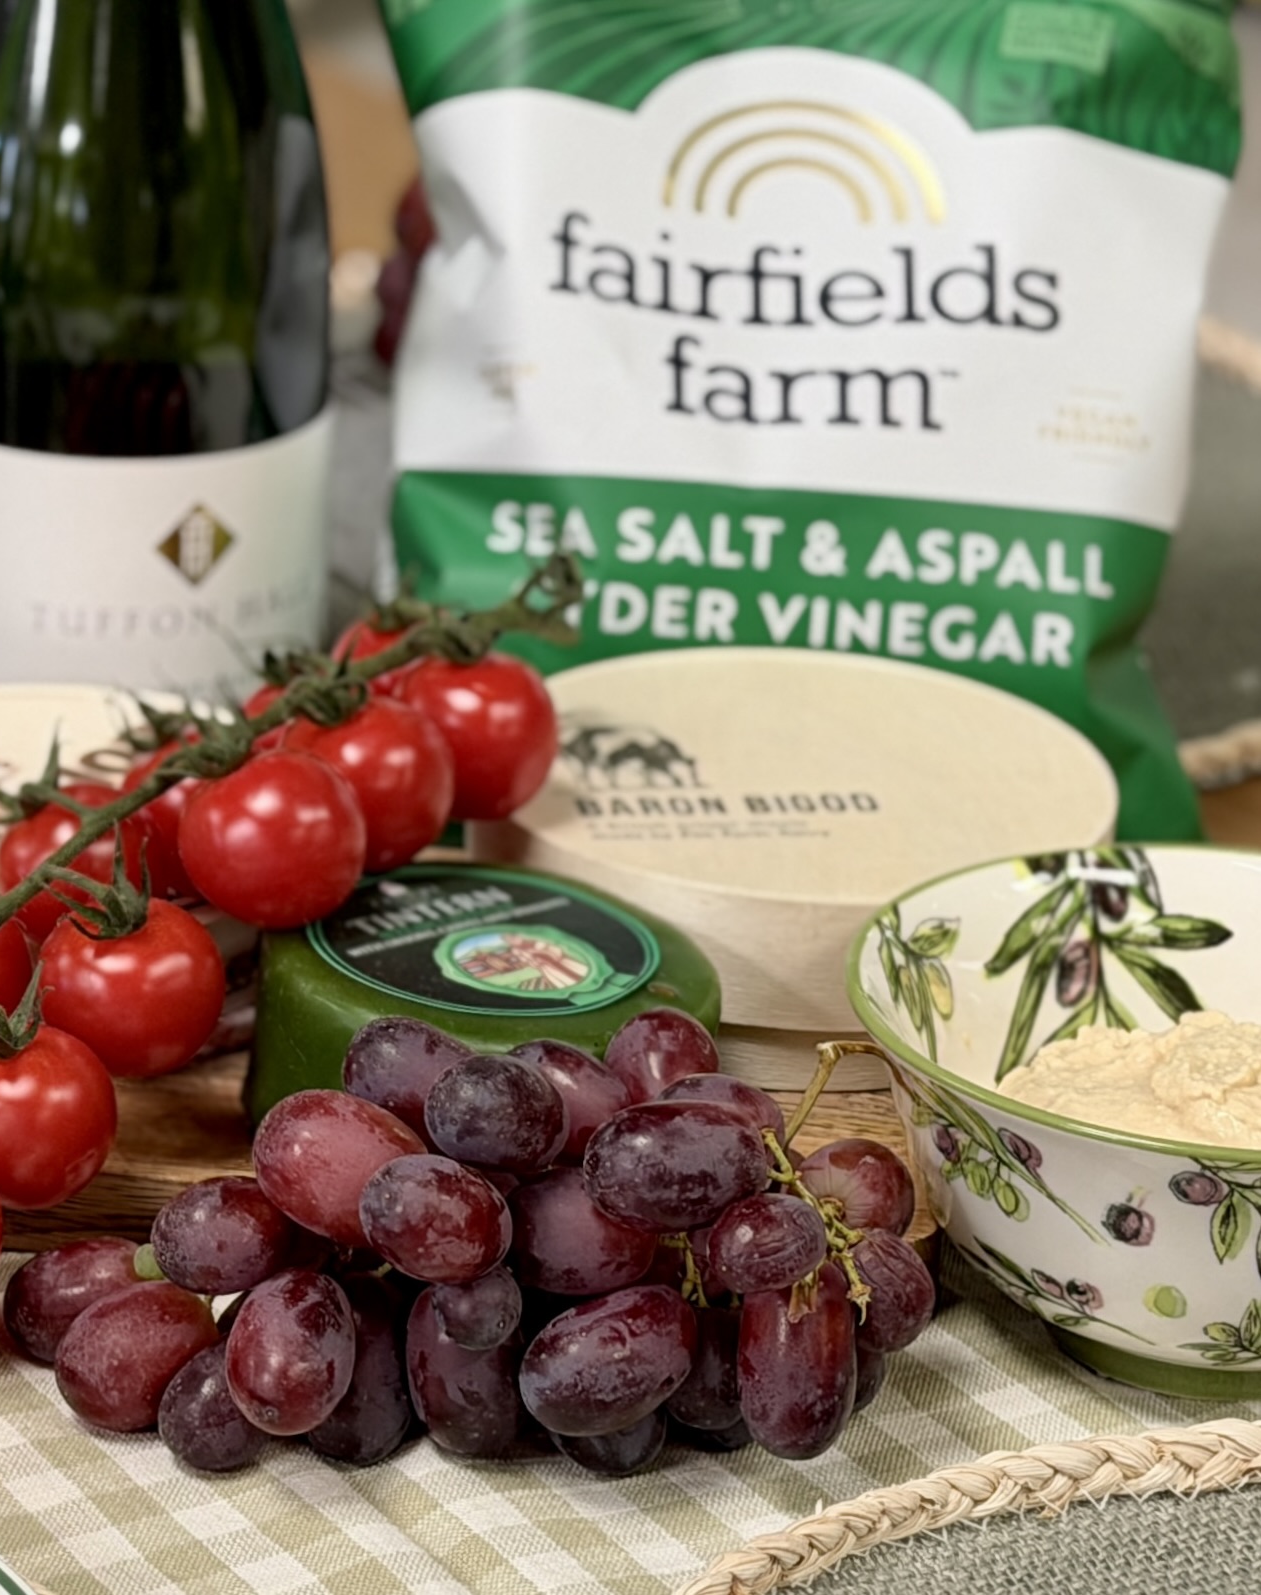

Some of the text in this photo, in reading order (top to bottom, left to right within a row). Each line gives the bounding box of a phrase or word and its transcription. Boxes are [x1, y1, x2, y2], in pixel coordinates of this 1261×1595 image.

[549, 211, 1061, 332] fairfields
[664, 335, 944, 432] farm
[485, 500, 1115, 600] SEA SALT & ASPALL
[528, 579, 1075, 668] DER VINEGAR
[574, 796, 728, 818] BARON
[344, 885, 514, 936] TINTERN
